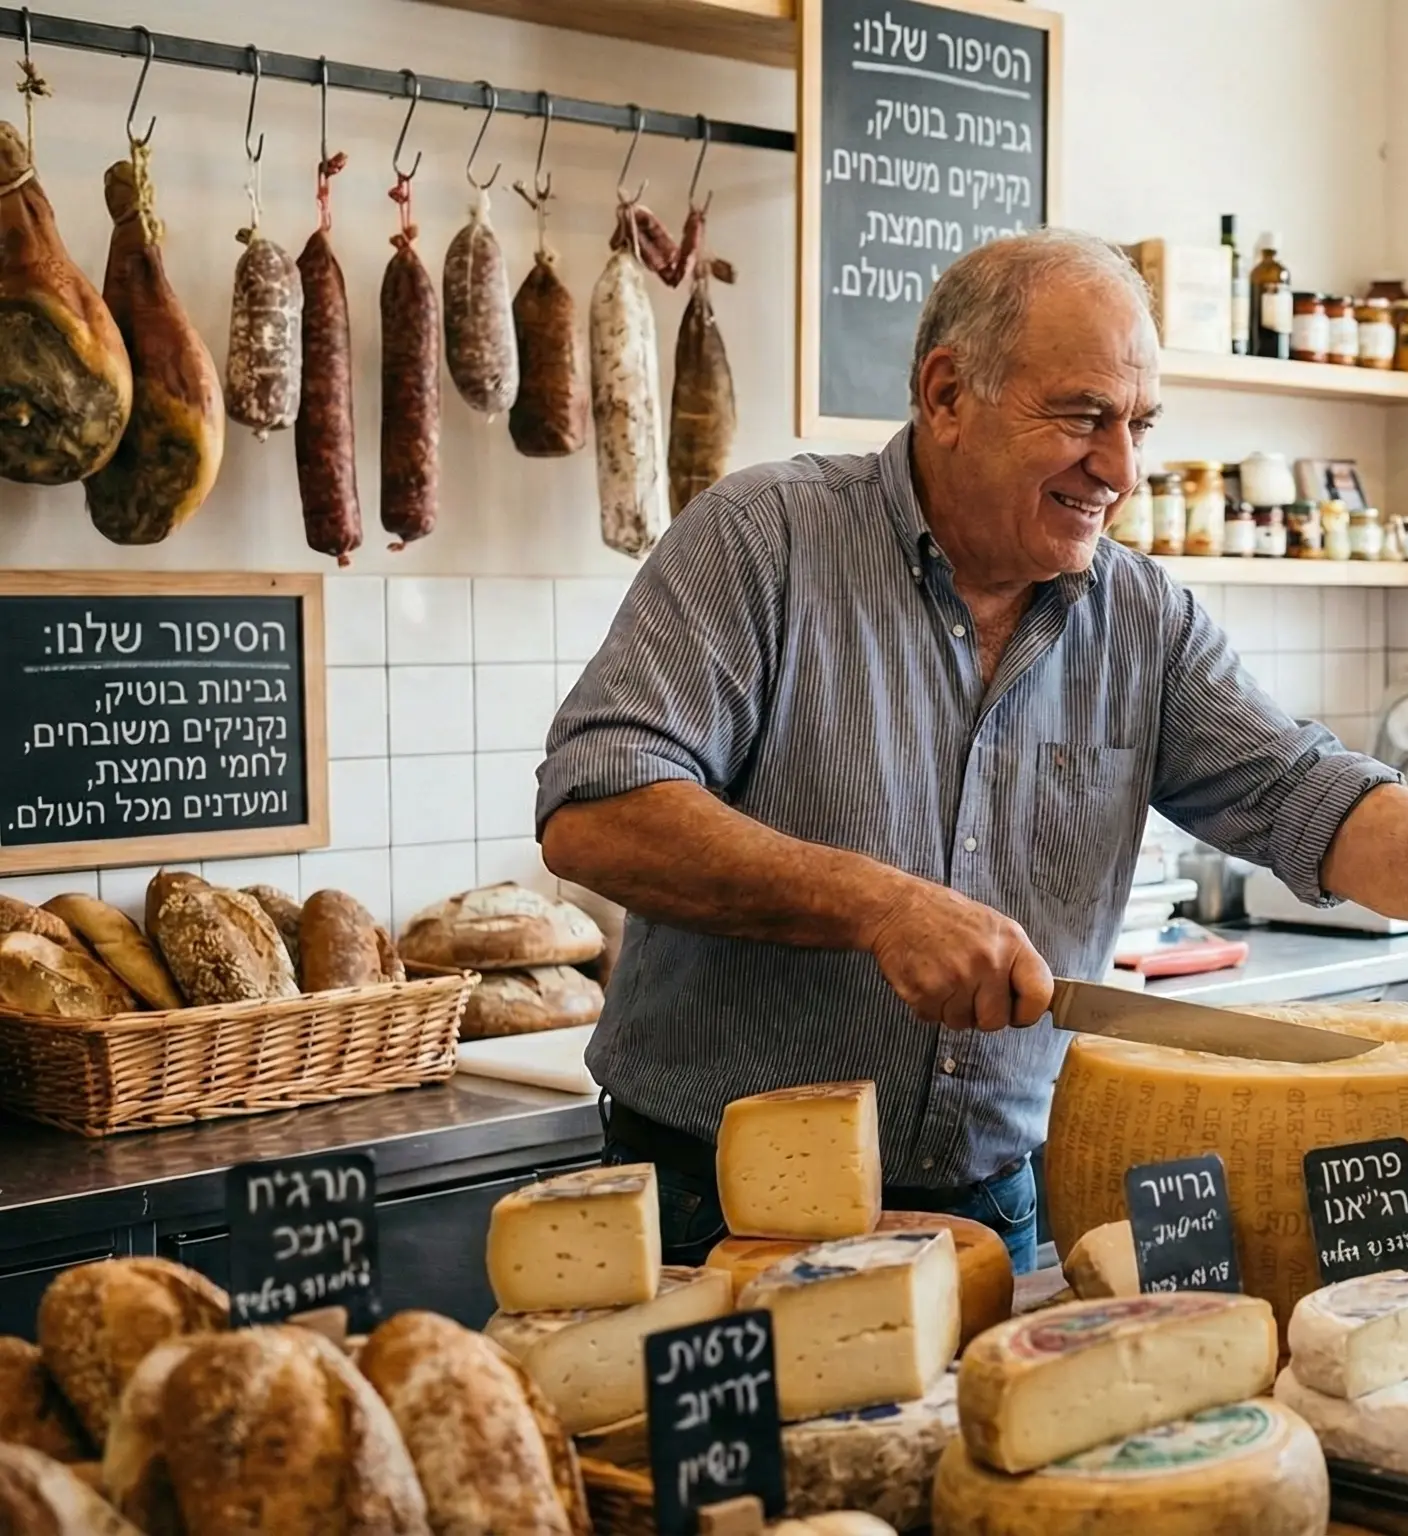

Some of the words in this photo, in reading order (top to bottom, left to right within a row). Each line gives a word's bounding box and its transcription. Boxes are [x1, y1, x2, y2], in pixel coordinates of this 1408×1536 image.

[853, 12, 927, 62] שלנו:
[939, 34, 1030, 82] הסיפור
[868, 100, 947, 139] בוטיק,
[956, 113, 1032, 152] גבינות
[826, 149, 939, 193] משובחים,
[949, 167, 1030, 214] נקניקים
[860, 211, 962, 253] מחמצת,
[833, 257, 922, 302] העולם.
[44, 611, 142, 654] שלנו:
[159, 621, 286, 653] הסיפור
[95, 681, 189, 715] בוטיק,
[198, 678, 287, 705] גבינות
[24, 719, 170, 754] משובחים,
[183, 716, 287, 751] נקניקים
[87, 755, 207, 791] מחמצת,
[220, 745, 287, 778] לחמי
[8, 796, 105, 830] העולם.
[115, 792, 171, 822] מכל
[183, 789, 288, 819] ומעדנים
[1321, 1152, 1403, 1196] פרמזן
